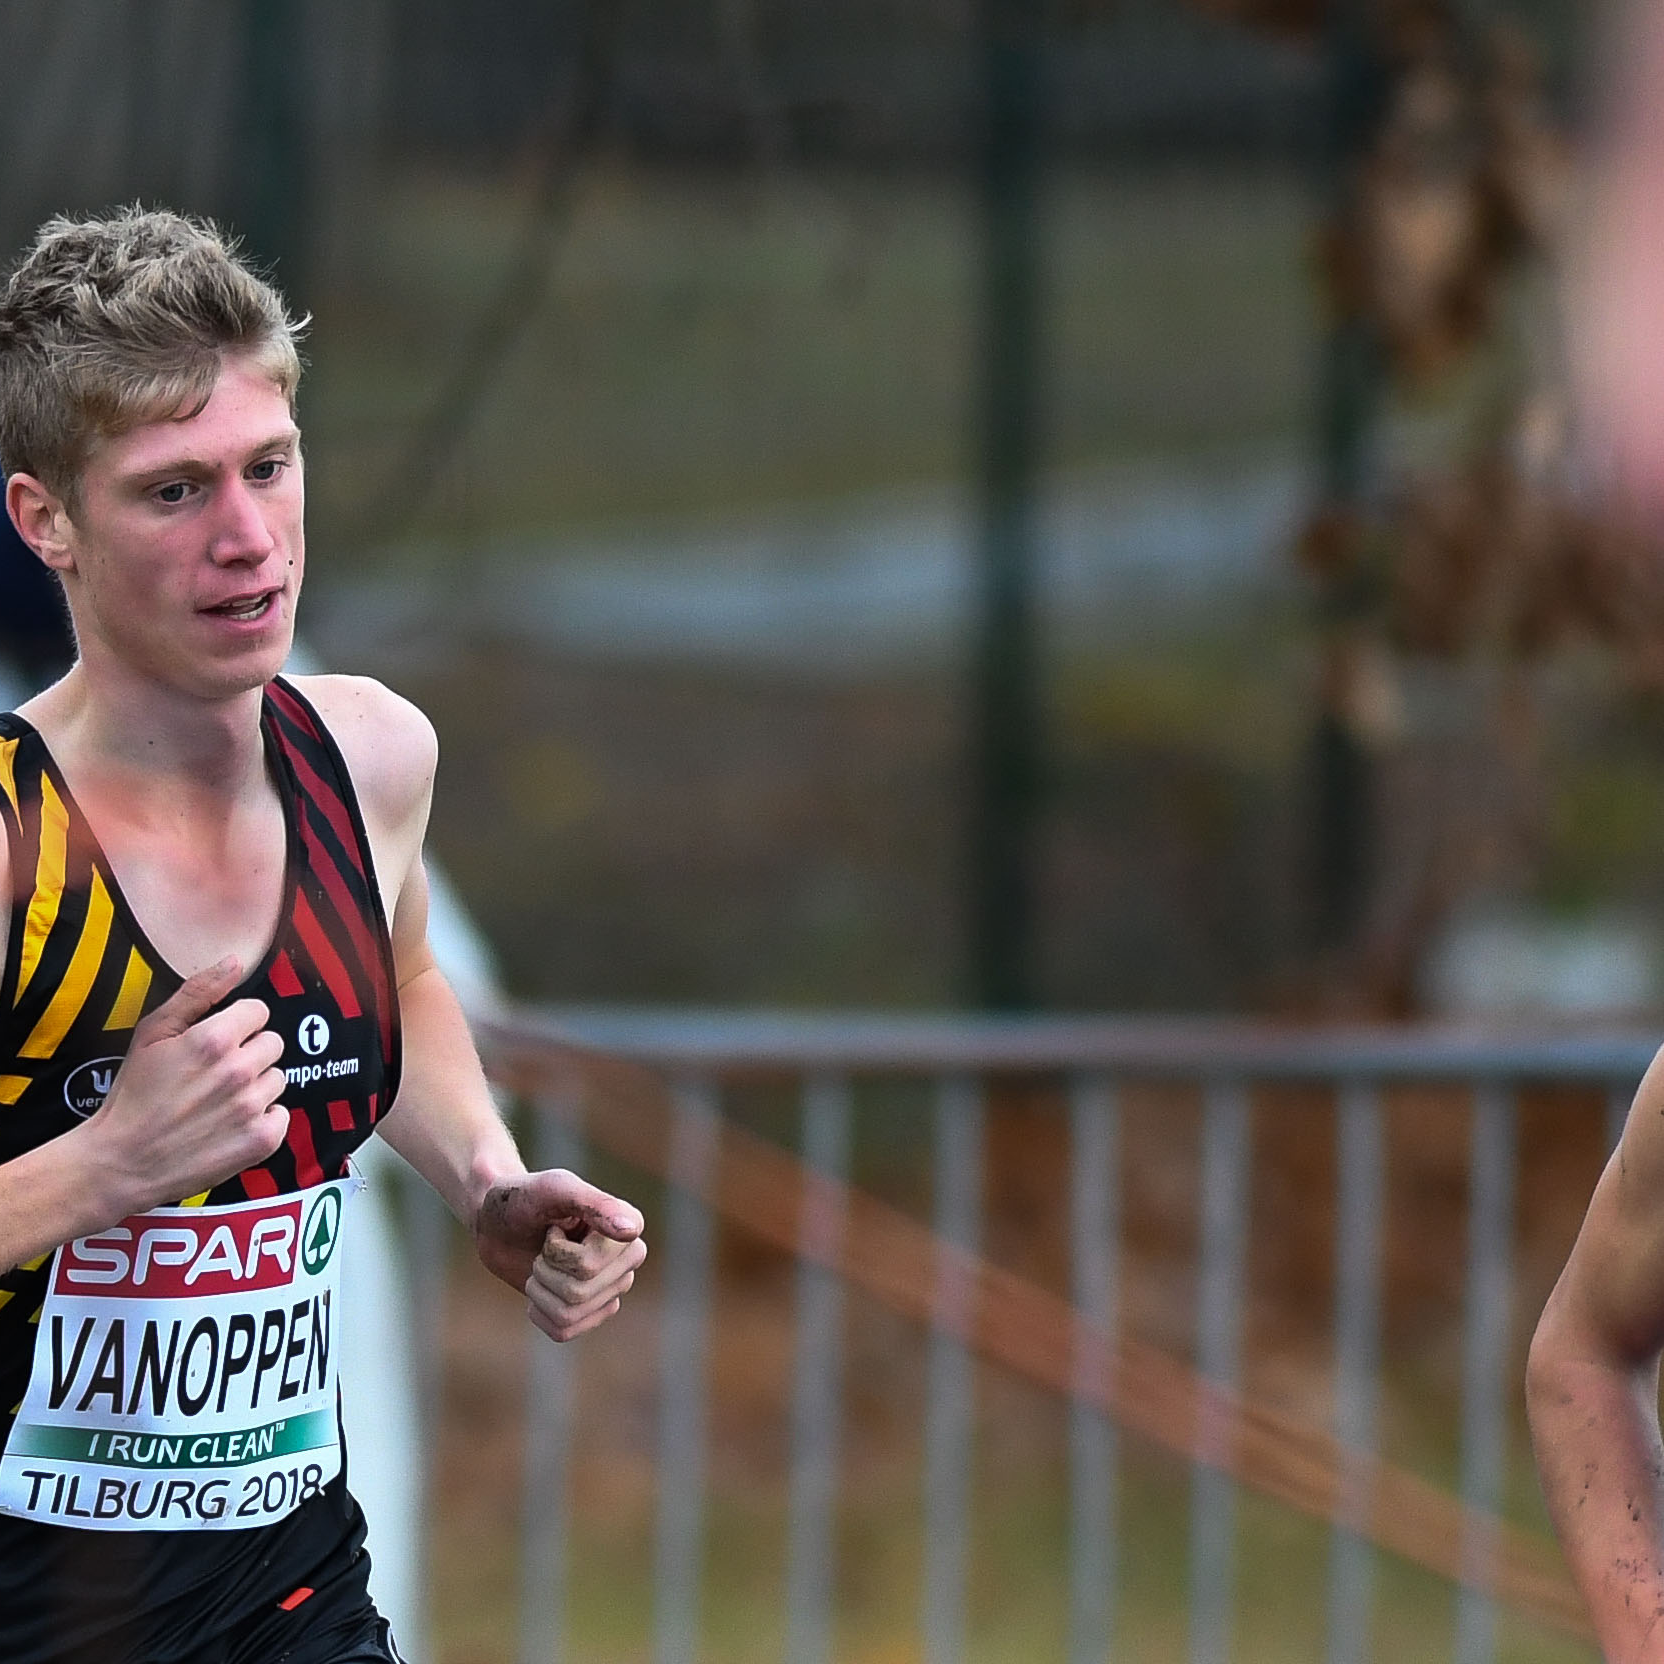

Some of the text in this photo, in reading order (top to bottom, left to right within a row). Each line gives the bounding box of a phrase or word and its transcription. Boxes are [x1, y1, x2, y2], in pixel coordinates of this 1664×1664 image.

[66, 1215, 297, 1286] SPAR
[46, 1287, 333, 1417] VANOPPEN
[88, 1433, 100, 1457] I
[107, 1433, 183, 1464] RUN
[189, 1426, 276, 1464] CLEAN
[21, 1463, 324, 1520] TILBURG 2018
